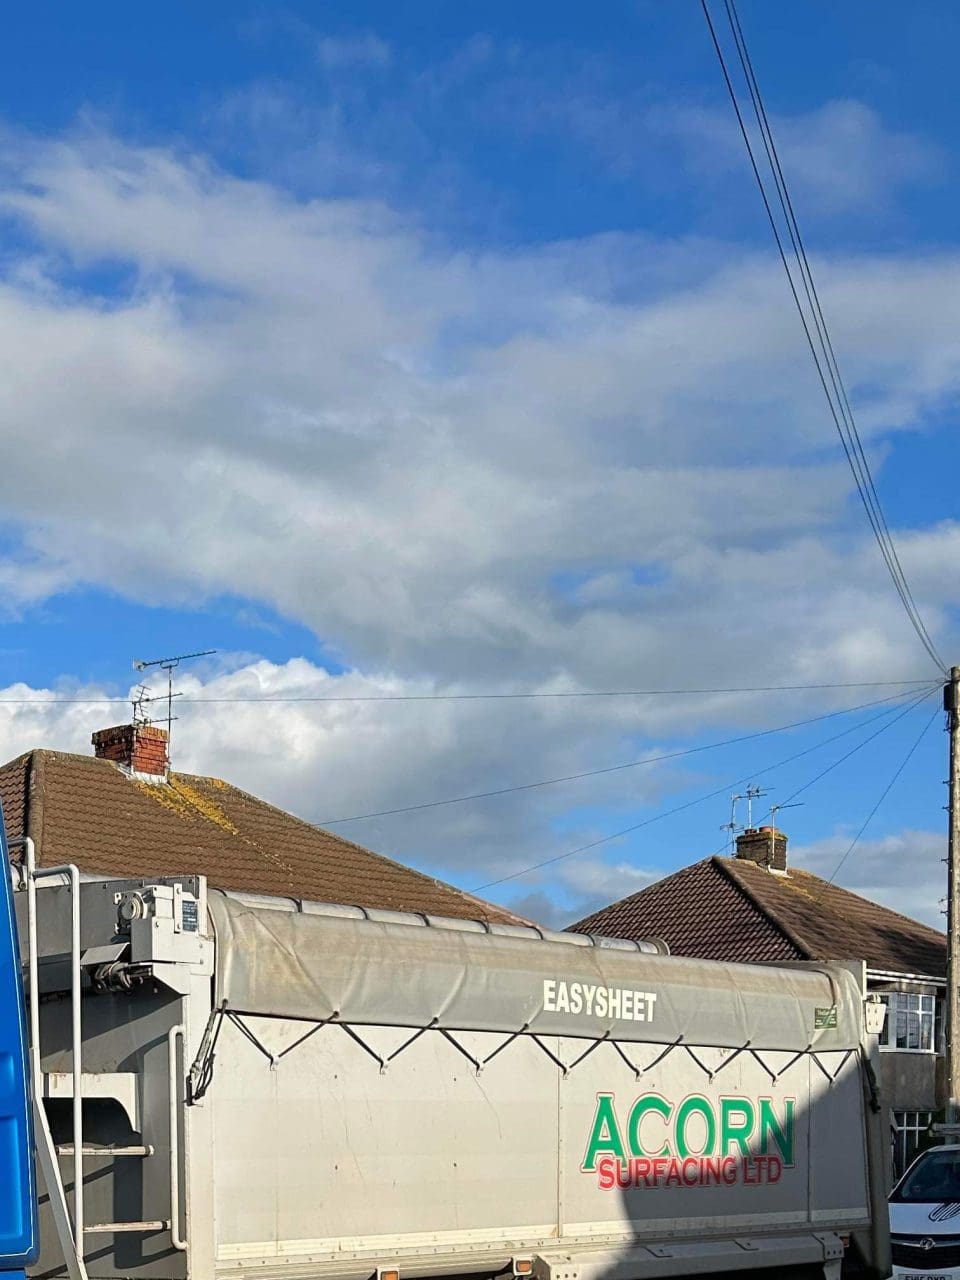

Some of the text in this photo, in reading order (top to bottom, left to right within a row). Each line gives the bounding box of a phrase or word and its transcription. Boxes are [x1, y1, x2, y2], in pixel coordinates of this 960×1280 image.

[543, 980, 657, 1022] EASYSHEET
[581, 1092, 796, 1173] ACORN
[598, 1156, 782, 1191] SURFACING LTD
